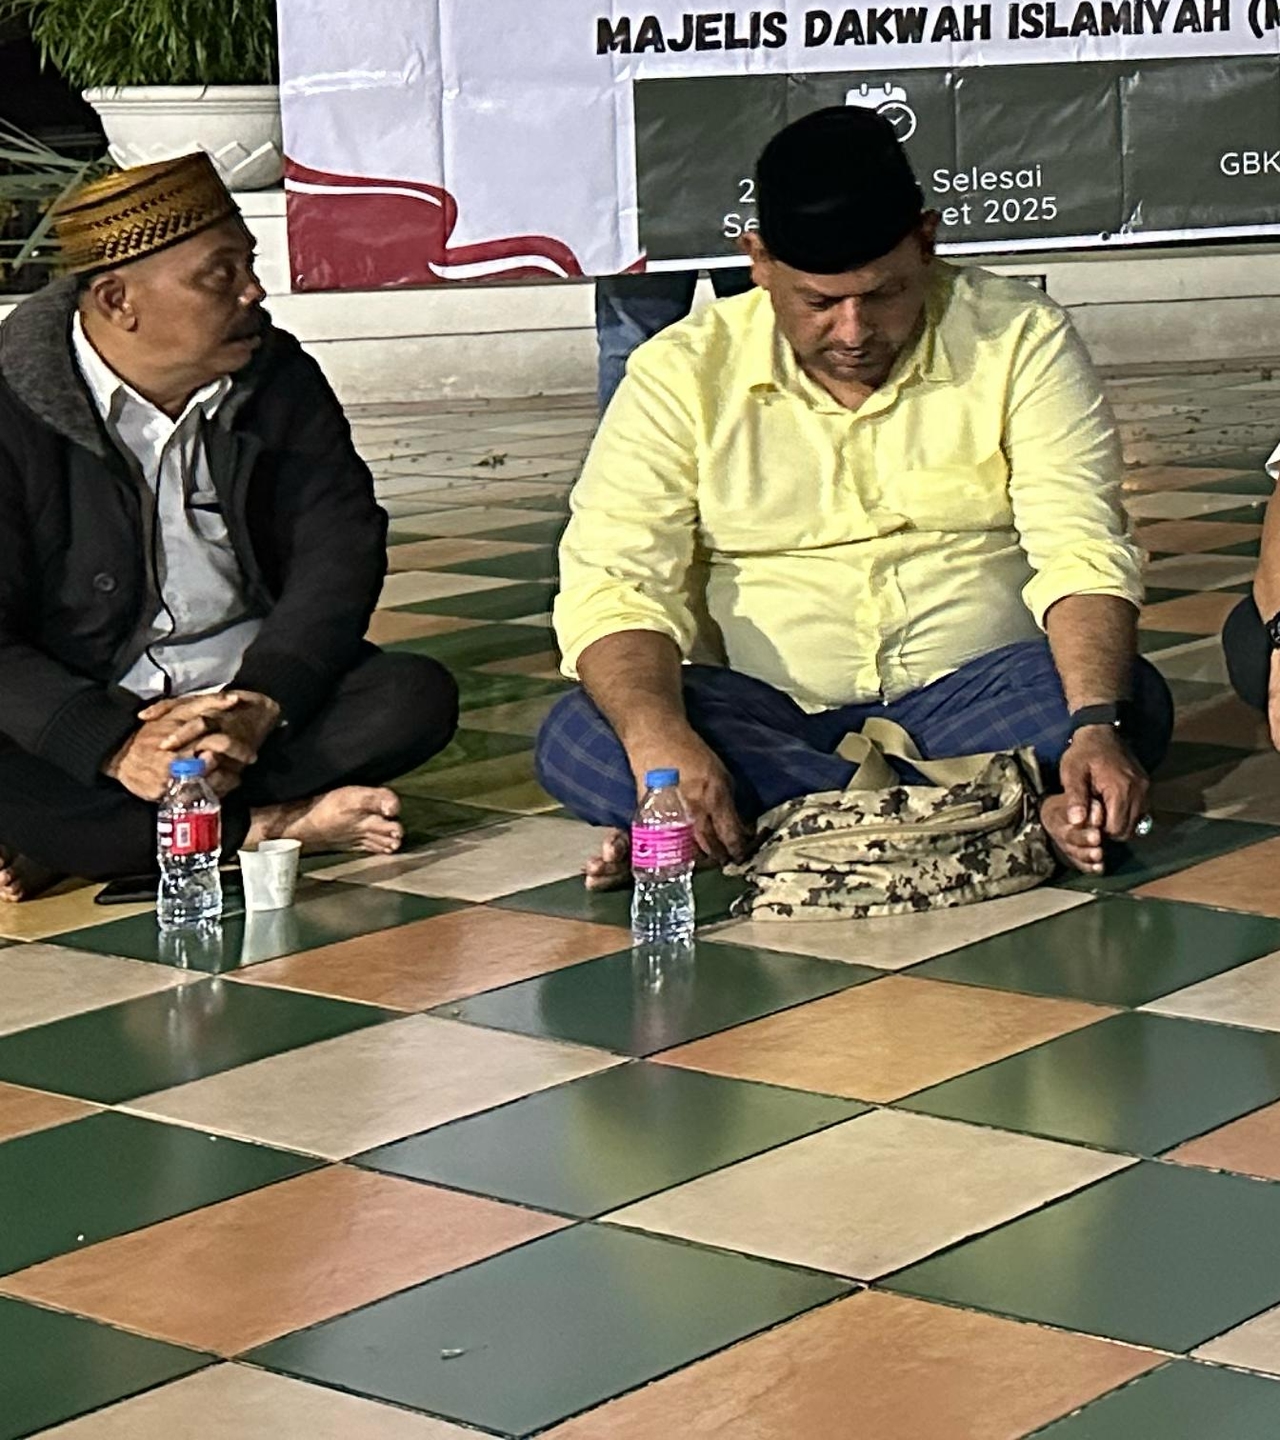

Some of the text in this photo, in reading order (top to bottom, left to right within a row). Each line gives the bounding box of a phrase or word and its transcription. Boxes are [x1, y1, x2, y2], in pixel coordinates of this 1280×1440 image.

[597, 12, 787, 55] MAJELIS
[805, 4, 991, 47] DAKWAH
[933, 165, 1041, 192] Selesai
[984, 197, 1057, 223] 2025
